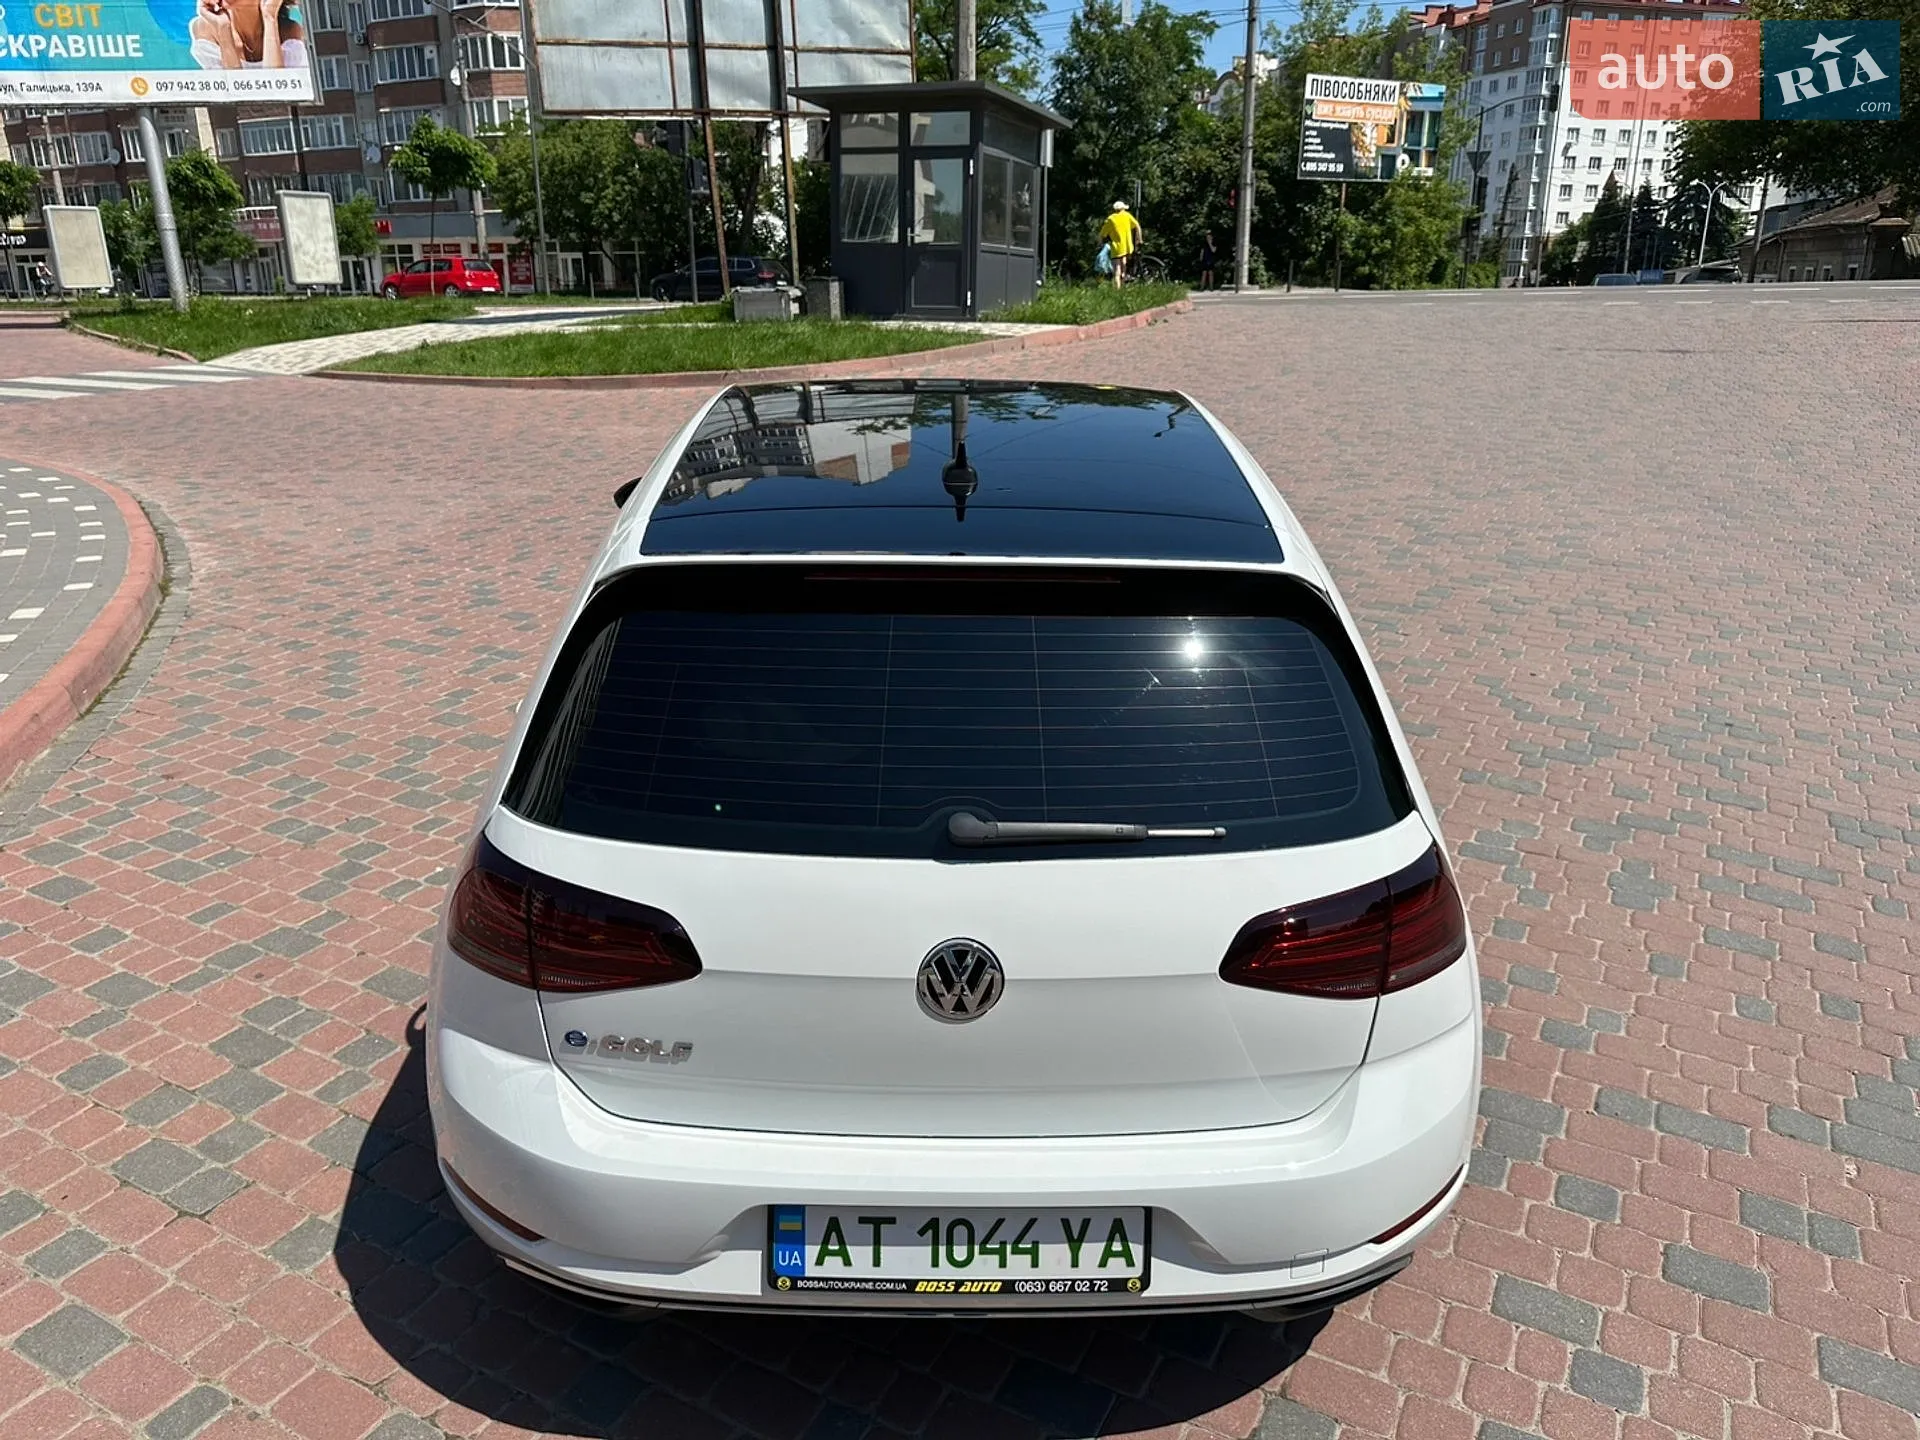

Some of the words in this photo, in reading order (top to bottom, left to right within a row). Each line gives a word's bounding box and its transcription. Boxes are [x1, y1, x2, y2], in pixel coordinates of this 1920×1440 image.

[35, 3, 102, 28] СВІТ
[20, 82, 74, 94] Галицька,
[156, 81, 174, 92] 097
[177, 81, 196, 92] 942
[198, 81, 211, 91] 38
[233, 80, 253, 91] 066
[255, 80, 273, 90] 541
[275, 79, 289, 89] 09
[291, 79, 303, 89] 51
[1310, 78, 1397, 103] ПІВОСОБНЯКИ
[815, 1216, 897, 1268] AT
[916, 1217, 1039, 1269] 1044
[1061, 1217, 1136, 1269] YA
[778, 1250, 803, 1267] UA
[797, 1279, 908, 1291] BOSSAUTOUKRAINE.COM.UA
[914, 1280, 956, 1293] BOSS
[958, 1280, 1003, 1293] AUTO
[1014, 1279, 1046, 1294] (063)
[1048, 1280, 1071, 1292] 667
[1073, 1280, 1091, 1292] 02
[1092, 1280, 1109, 1291] 72
